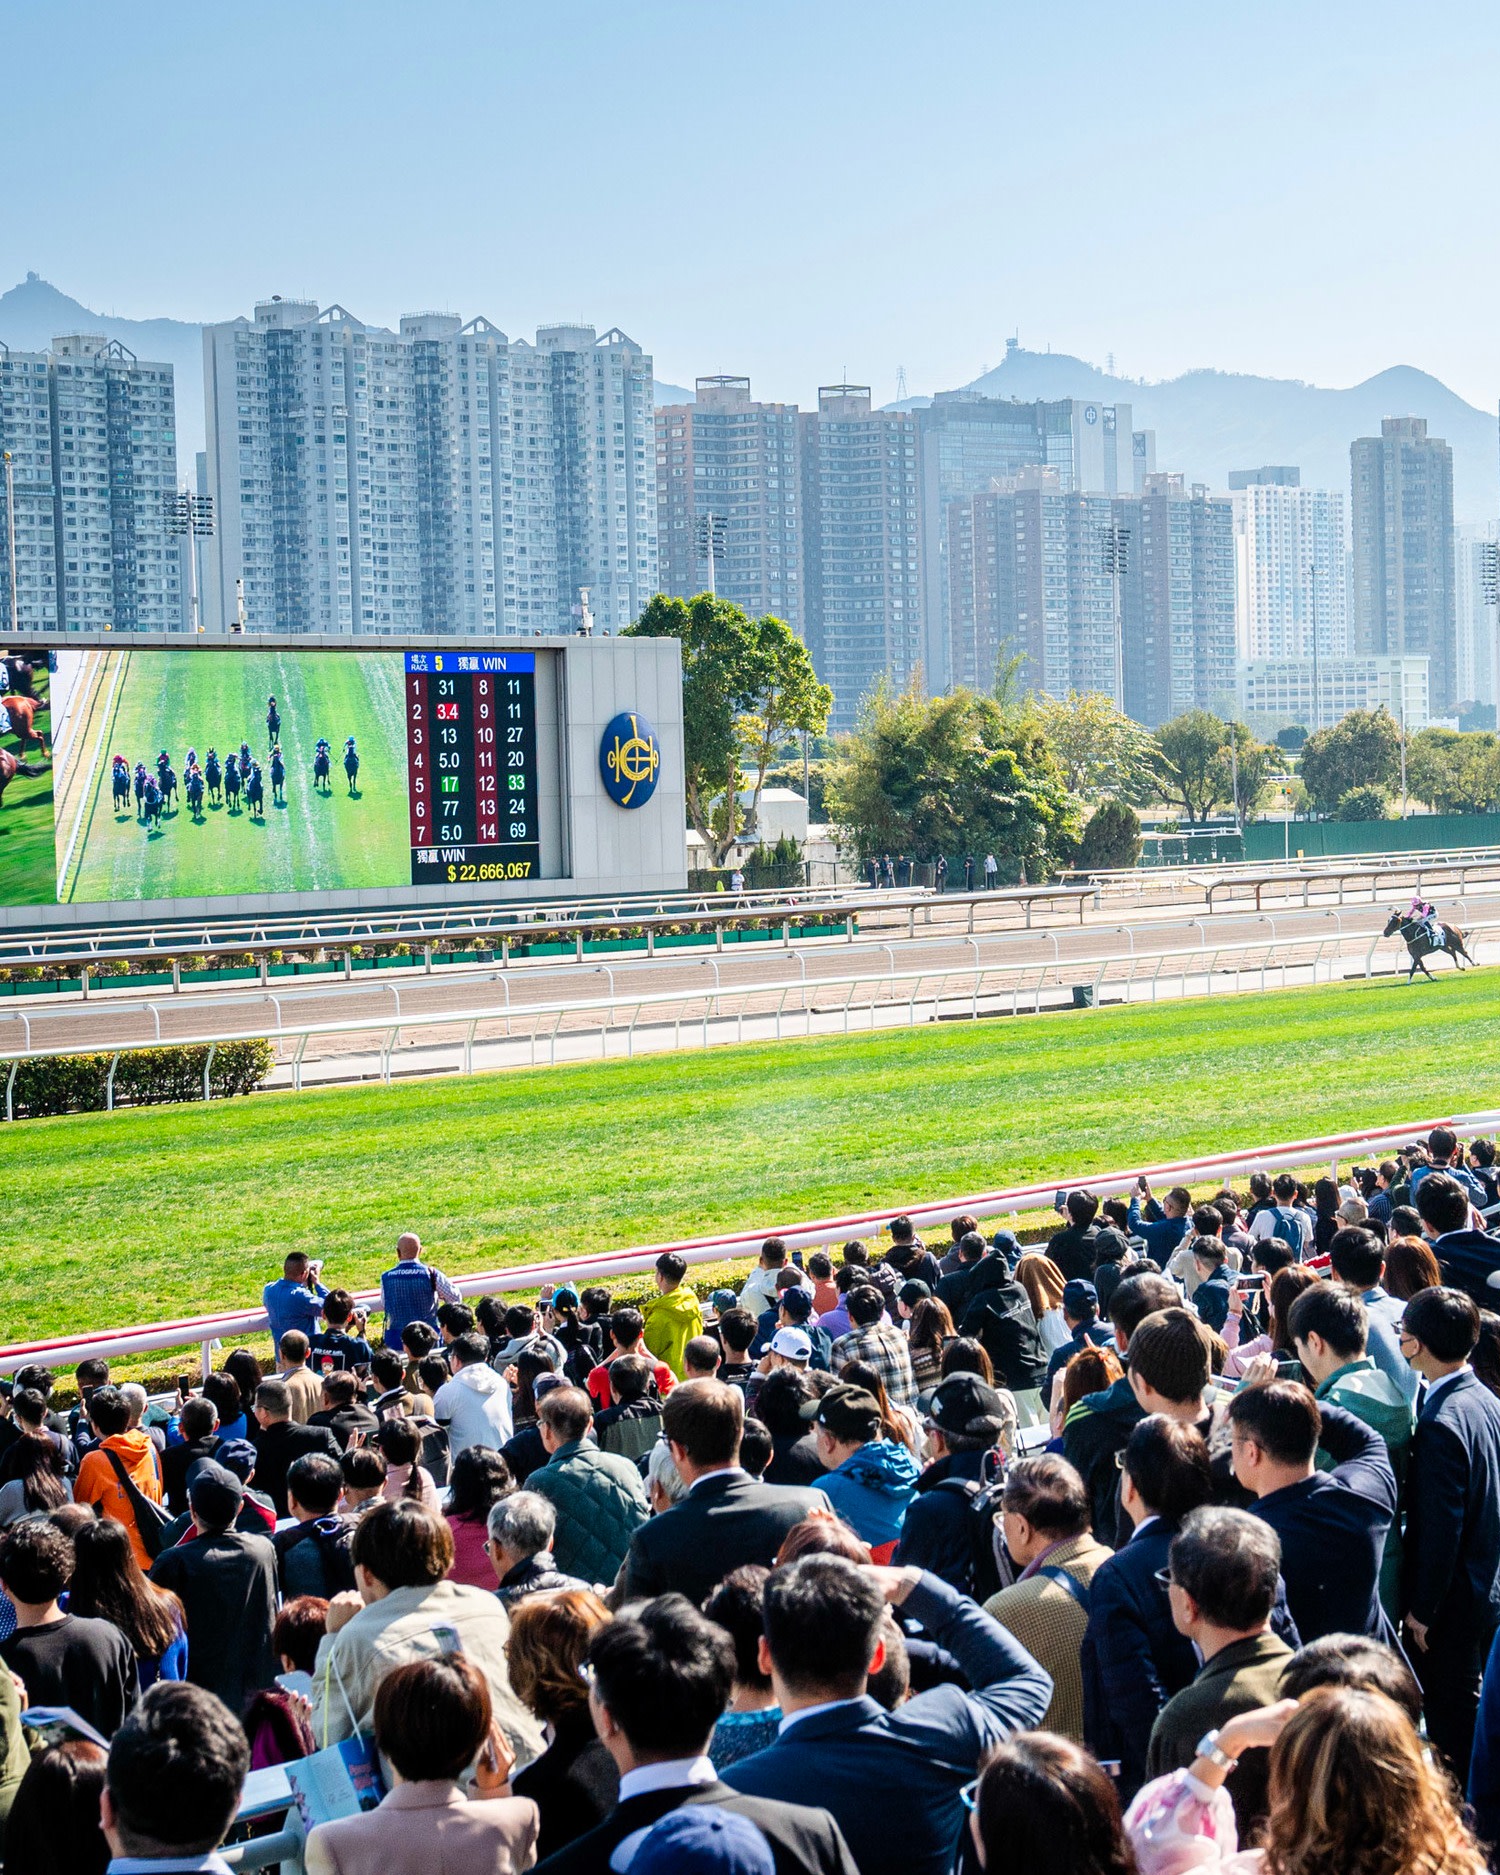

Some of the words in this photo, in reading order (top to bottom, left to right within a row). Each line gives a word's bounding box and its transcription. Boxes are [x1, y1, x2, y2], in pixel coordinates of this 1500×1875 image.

[435, 655, 443, 671] 5
[482, 657, 507, 671] WIN
[413, 680, 420, 695] 1
[439, 680, 454, 695] 31
[479, 680, 488, 695] 8
[507, 680, 520, 695] 11
[413, 704, 422, 719] 2
[437, 704, 458, 719] 3.4
[480, 704, 488, 719] 9
[507, 703, 521, 718] 11
[414, 728, 422, 744] 3
[441, 728, 457, 743] 13
[477, 727, 493, 743] 10
[507, 727, 523, 742] 27
[414, 753, 423, 768] 4
[439, 753, 459, 768] 5.0
[478, 752, 492, 767] 11
[508, 751, 524, 766] 20
[415, 777, 424, 793] 5
[442, 776, 458, 792] 17
[479, 776, 495, 791] 12
[509, 775, 525, 790] 33
[416, 802, 425, 817] 6
[442, 801, 459, 816] 77
[480, 800, 495, 815] 13
[509, 799, 525, 814] 24
[417, 826, 426, 841] 7
[441, 825, 462, 840] 5.0
[480, 824, 496, 839] 14
[510, 823, 526, 838] 69
[441, 848, 466, 863] WIN
[447, 865, 457, 882] $
[459, 862, 531, 881] 22,666,067
